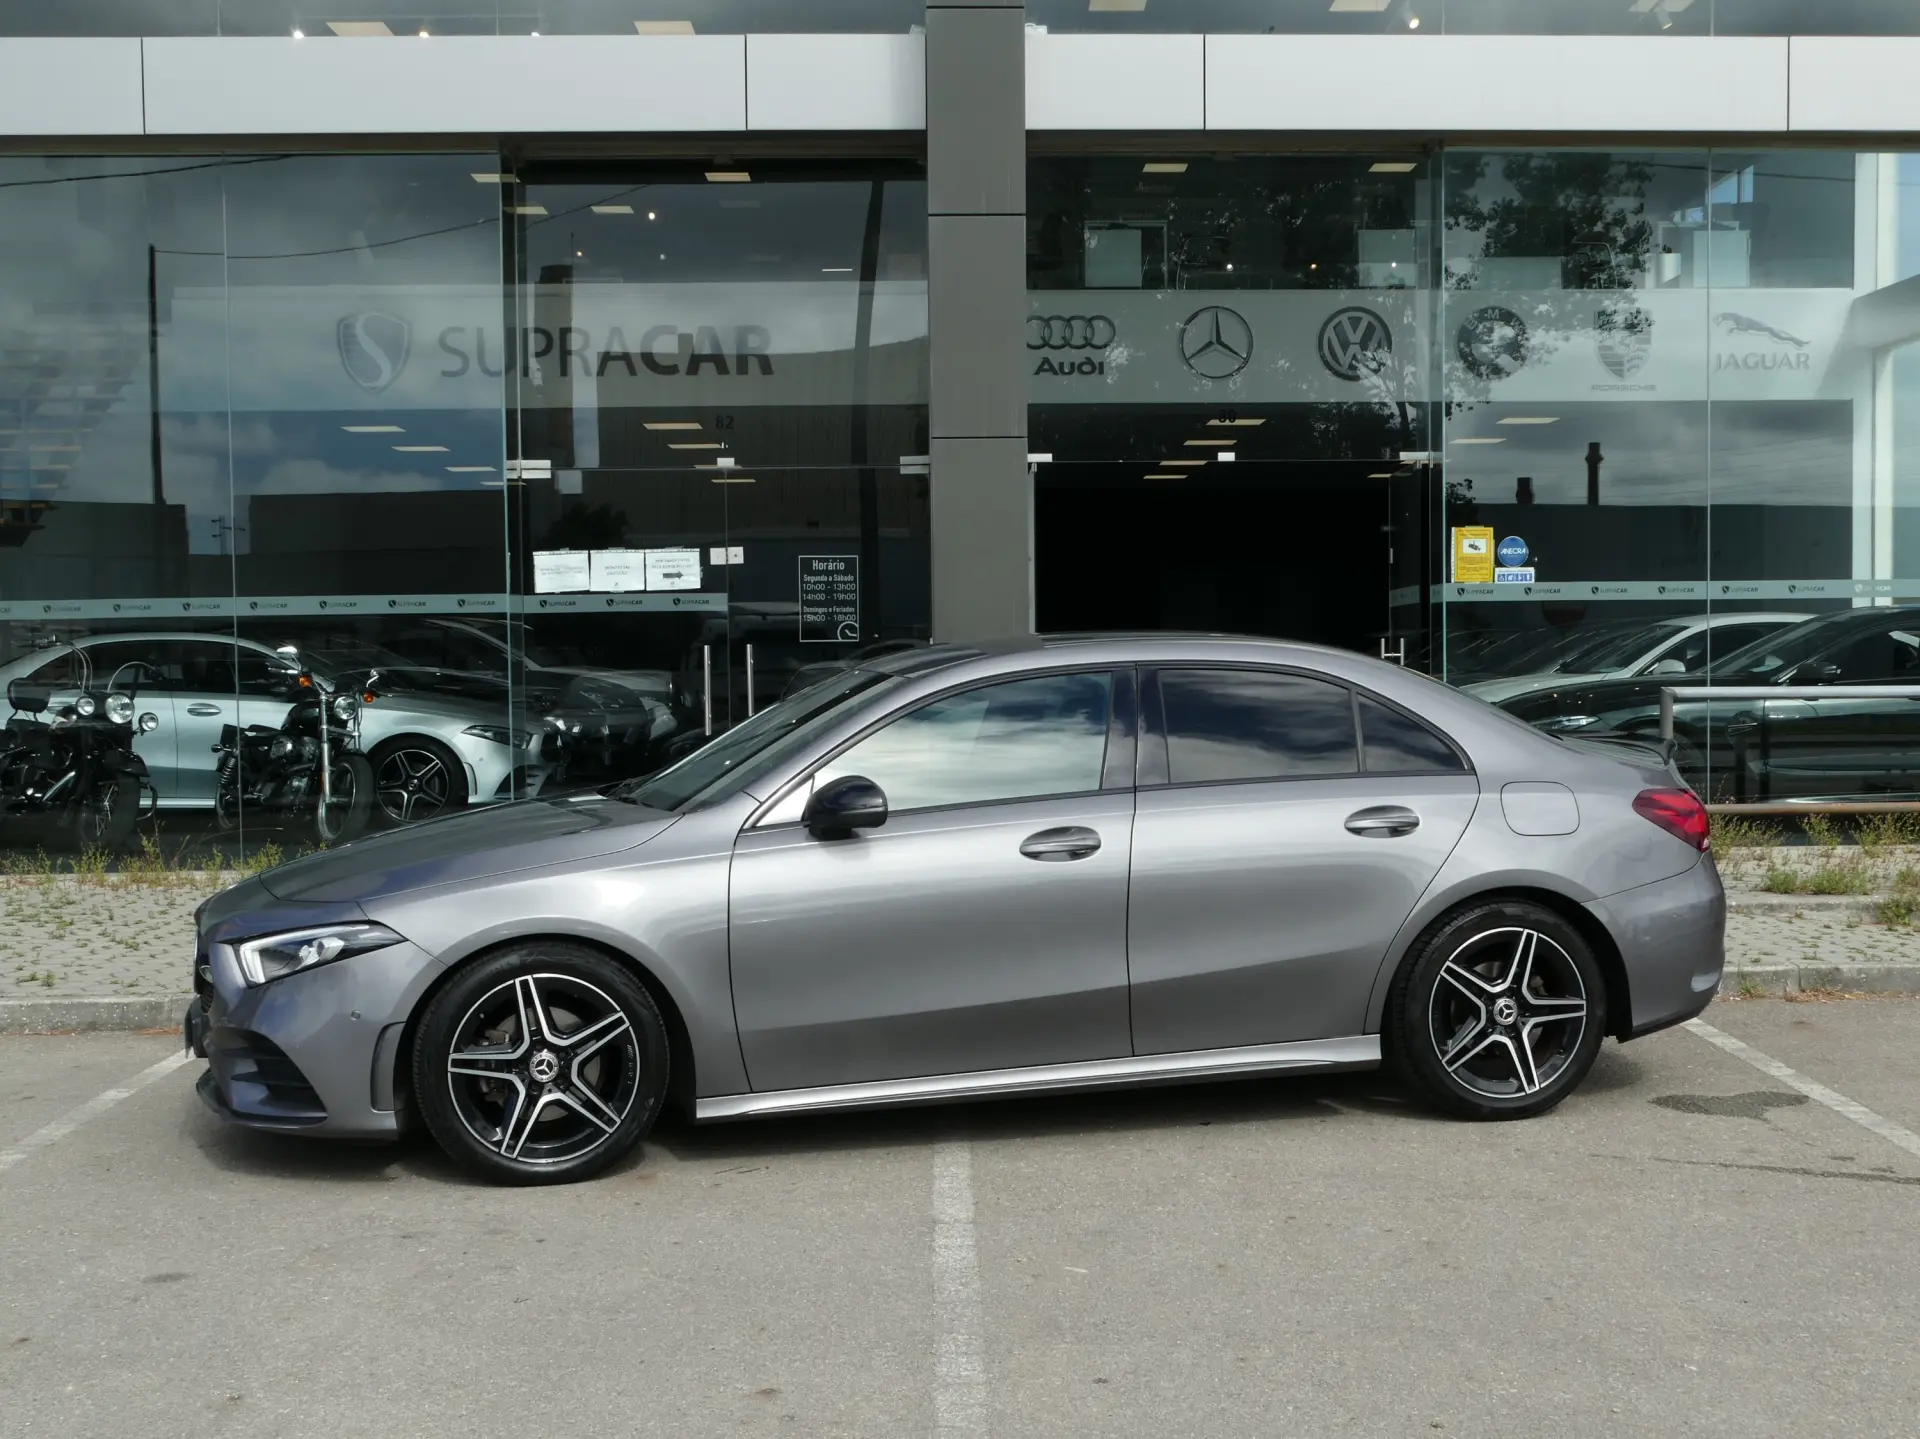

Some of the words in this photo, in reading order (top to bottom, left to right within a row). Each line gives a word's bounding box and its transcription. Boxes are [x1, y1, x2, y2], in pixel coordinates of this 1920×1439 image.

[438, 325, 775, 378] SUPRACAR
[1034, 356, 1105, 376] Audi
[1713, 351, 1811, 374] JAGUAR
[716, 413, 734, 430] 82
[1500, 547, 1526, 555] ANECRA
[812, 559, 845, 570] Horário
[803, 574, 828, 583] Segunda
